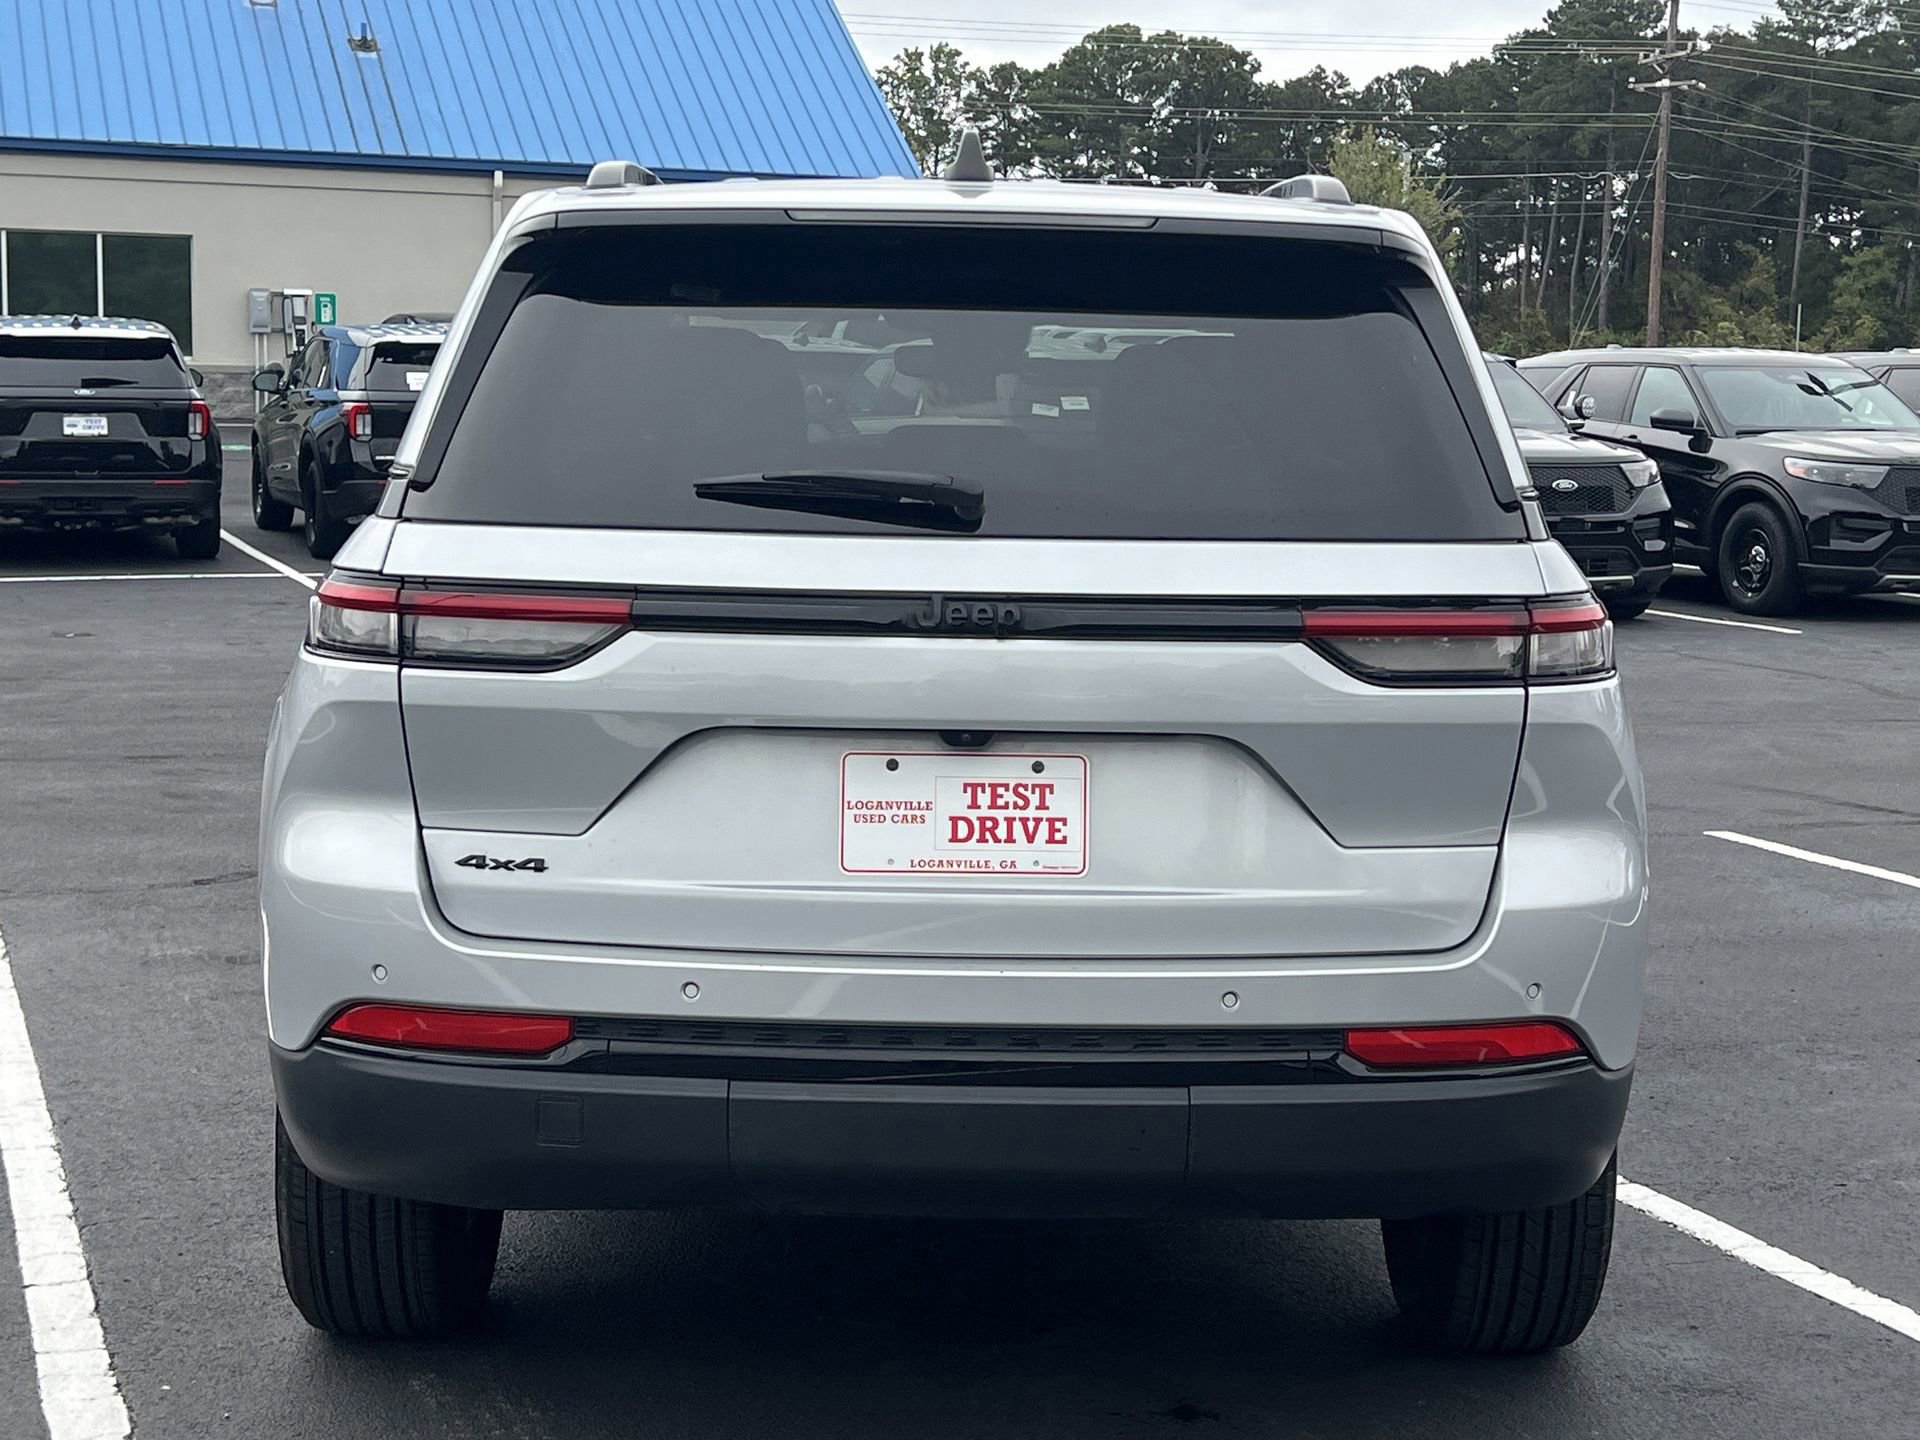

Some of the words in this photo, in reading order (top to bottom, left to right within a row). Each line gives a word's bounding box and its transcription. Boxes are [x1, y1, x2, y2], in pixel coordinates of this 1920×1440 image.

[917, 593, 1021, 634] Jeep
[846, 800, 933, 811] LOGANVILLE
[962, 782, 1054, 811] TEST
[853, 814, 886, 824] USED
[891, 814, 926, 825] CARS
[948, 815, 1068, 845] DRIVE
[454, 854, 549, 873] 4x4
[910, 859, 996, 870] LOGANVILLE,
[1000, 860, 1017, 869] GA
